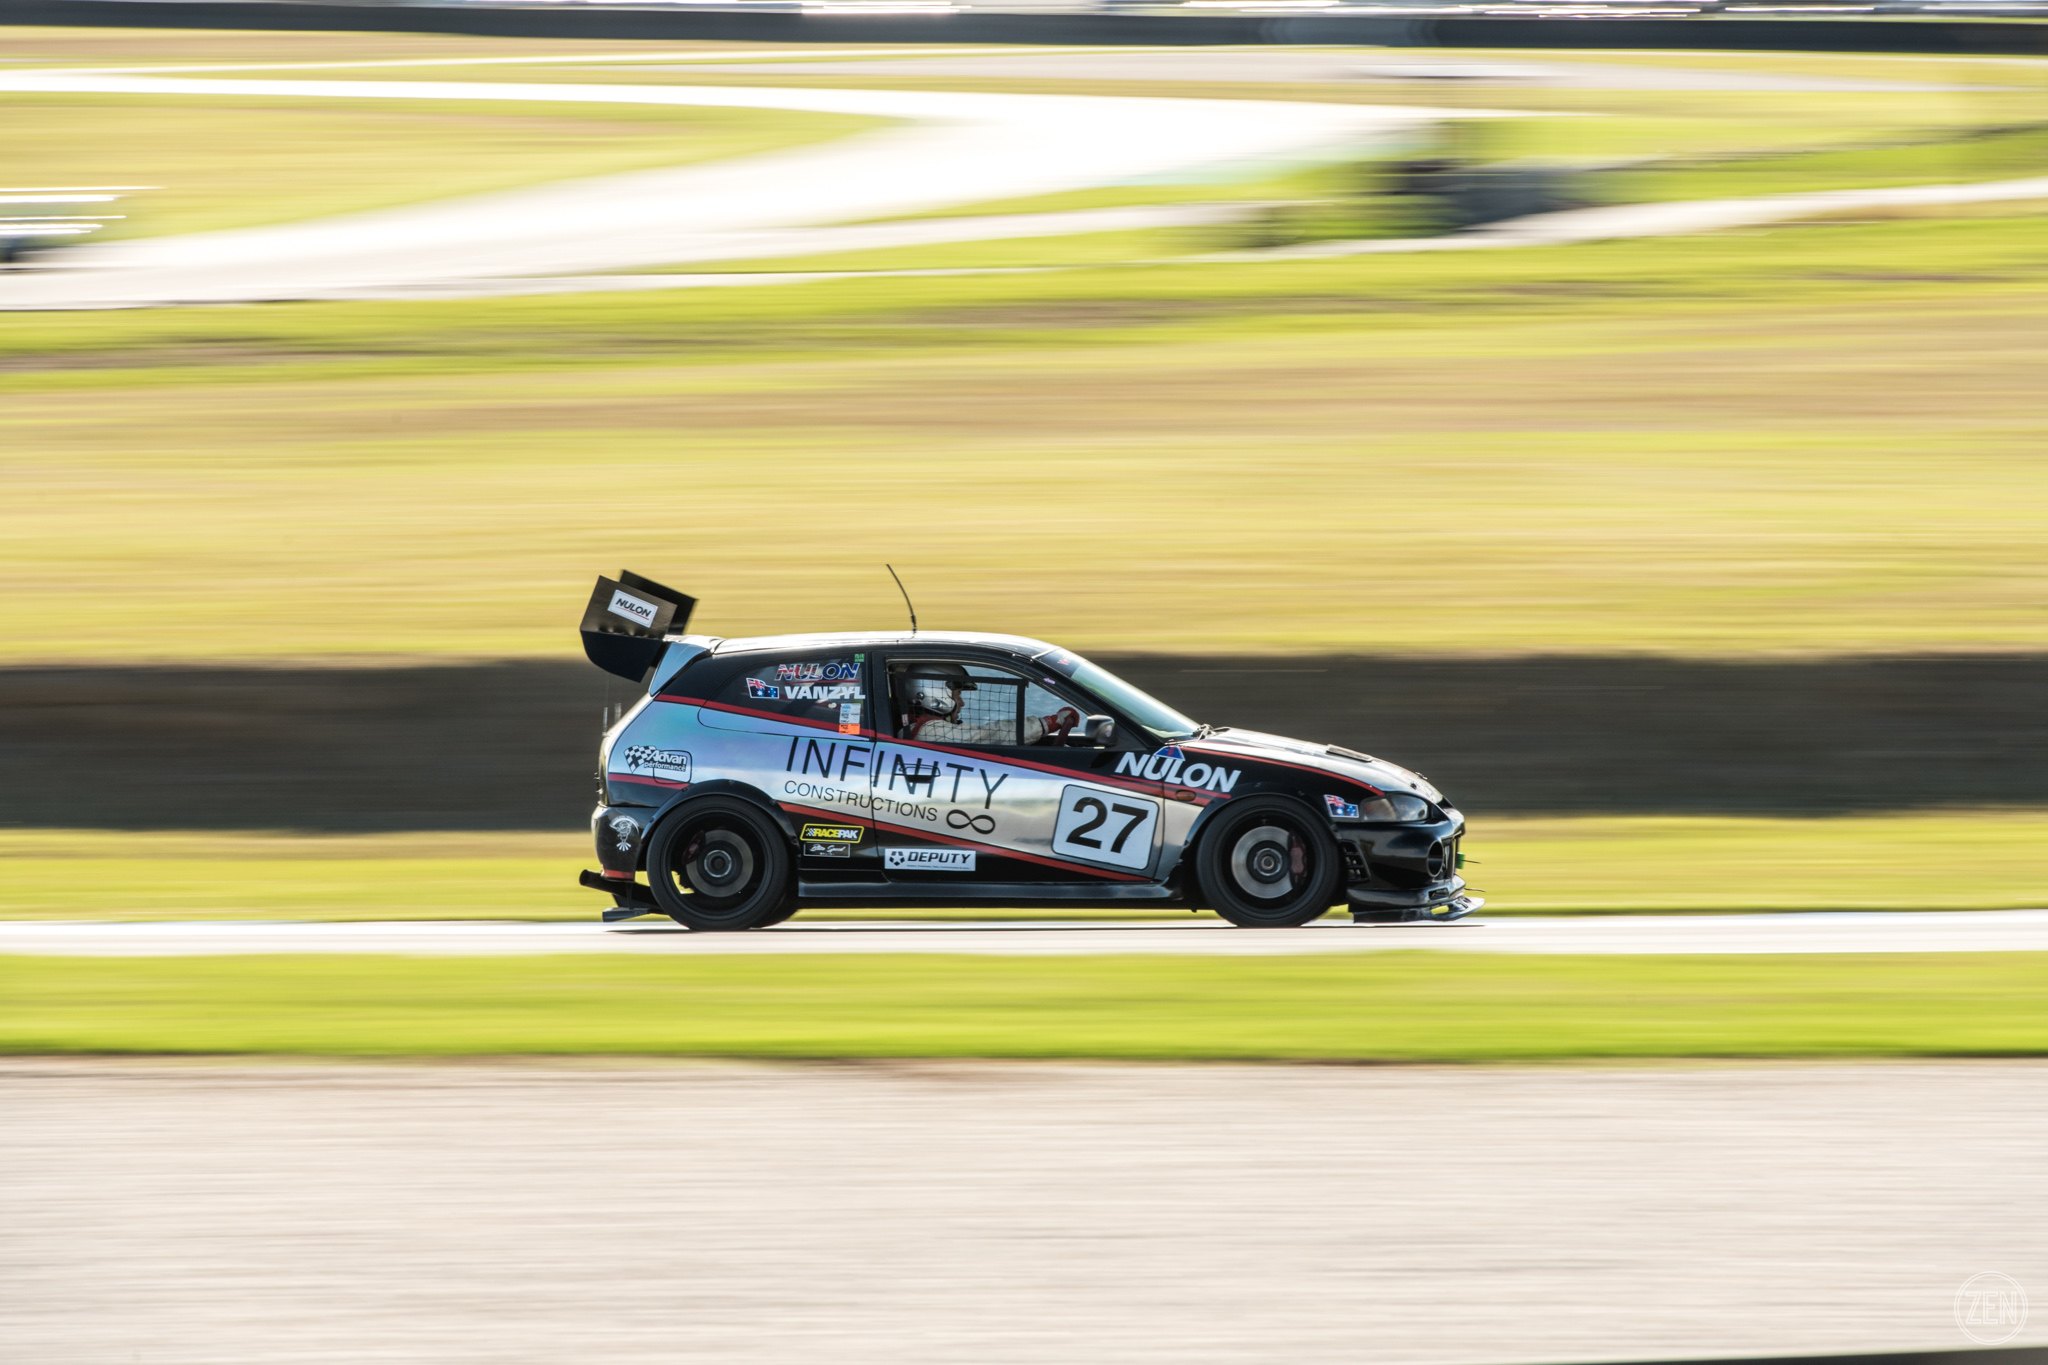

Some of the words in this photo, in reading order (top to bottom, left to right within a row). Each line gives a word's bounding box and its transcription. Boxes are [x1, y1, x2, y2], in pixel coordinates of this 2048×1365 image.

[615, 598, 652, 617] NULON
[774, 663, 861, 681] NULON
[784, 686, 866, 700] VANZYL
[644, 761, 686, 772] performance
[646, 750, 687, 765] Advan
[786, 736, 1009, 809] INFINITY
[1114, 751, 1241, 793] NULON
[784, 780, 938, 822] CONSTRUCTIONS
[814, 828, 858, 839] RACEPAK
[1066, 796, 1149, 854] 27
[907, 851, 972, 864] DEPUTY
